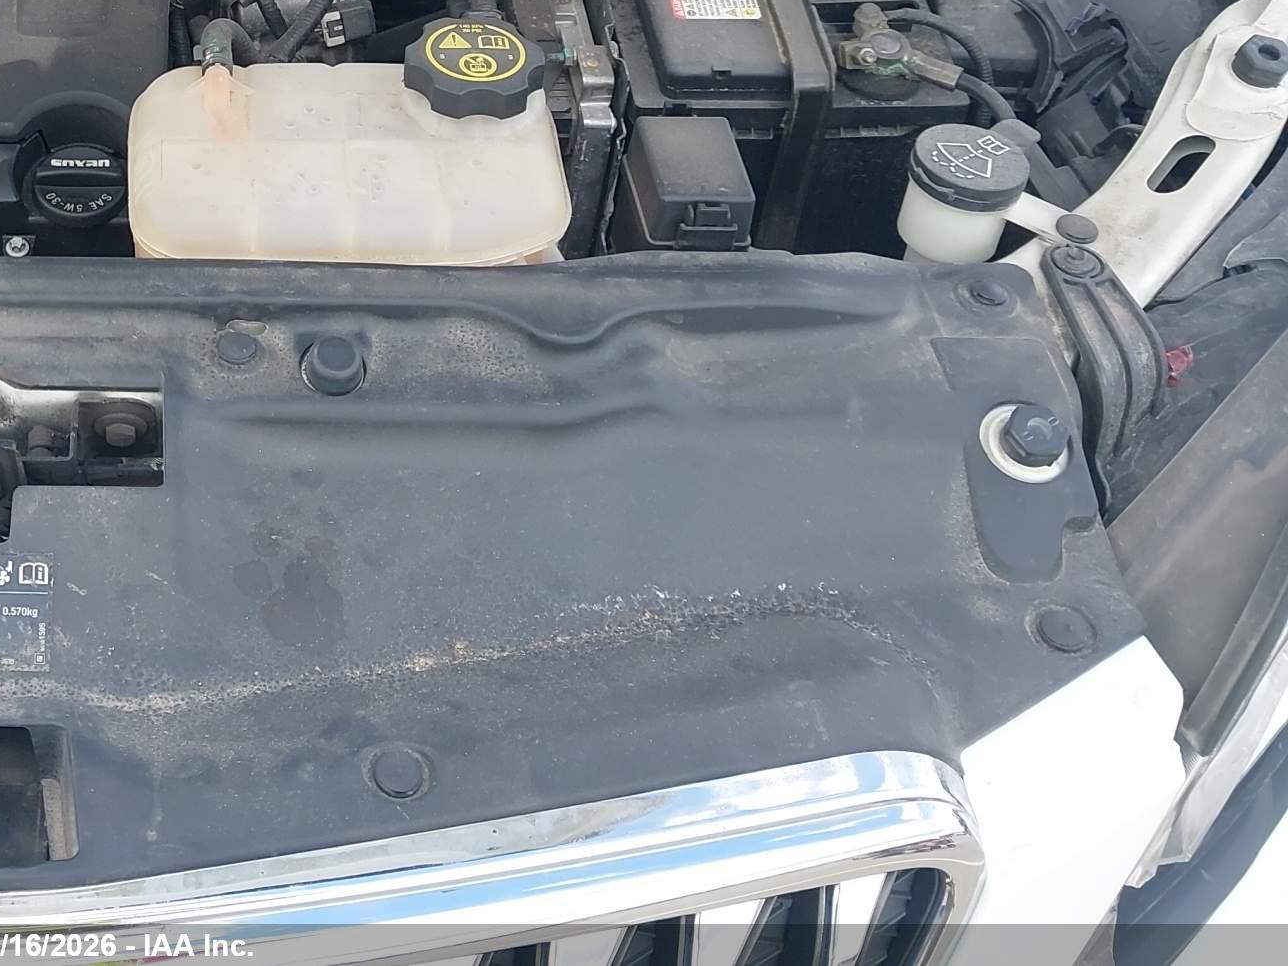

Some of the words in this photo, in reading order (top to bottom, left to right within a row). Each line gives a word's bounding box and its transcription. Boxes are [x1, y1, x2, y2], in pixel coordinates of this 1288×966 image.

[45, 192, 84, 213] 5W-30
[88, 193, 113, 211] SAE
[2, 607, 39, 618] 0.570kg
